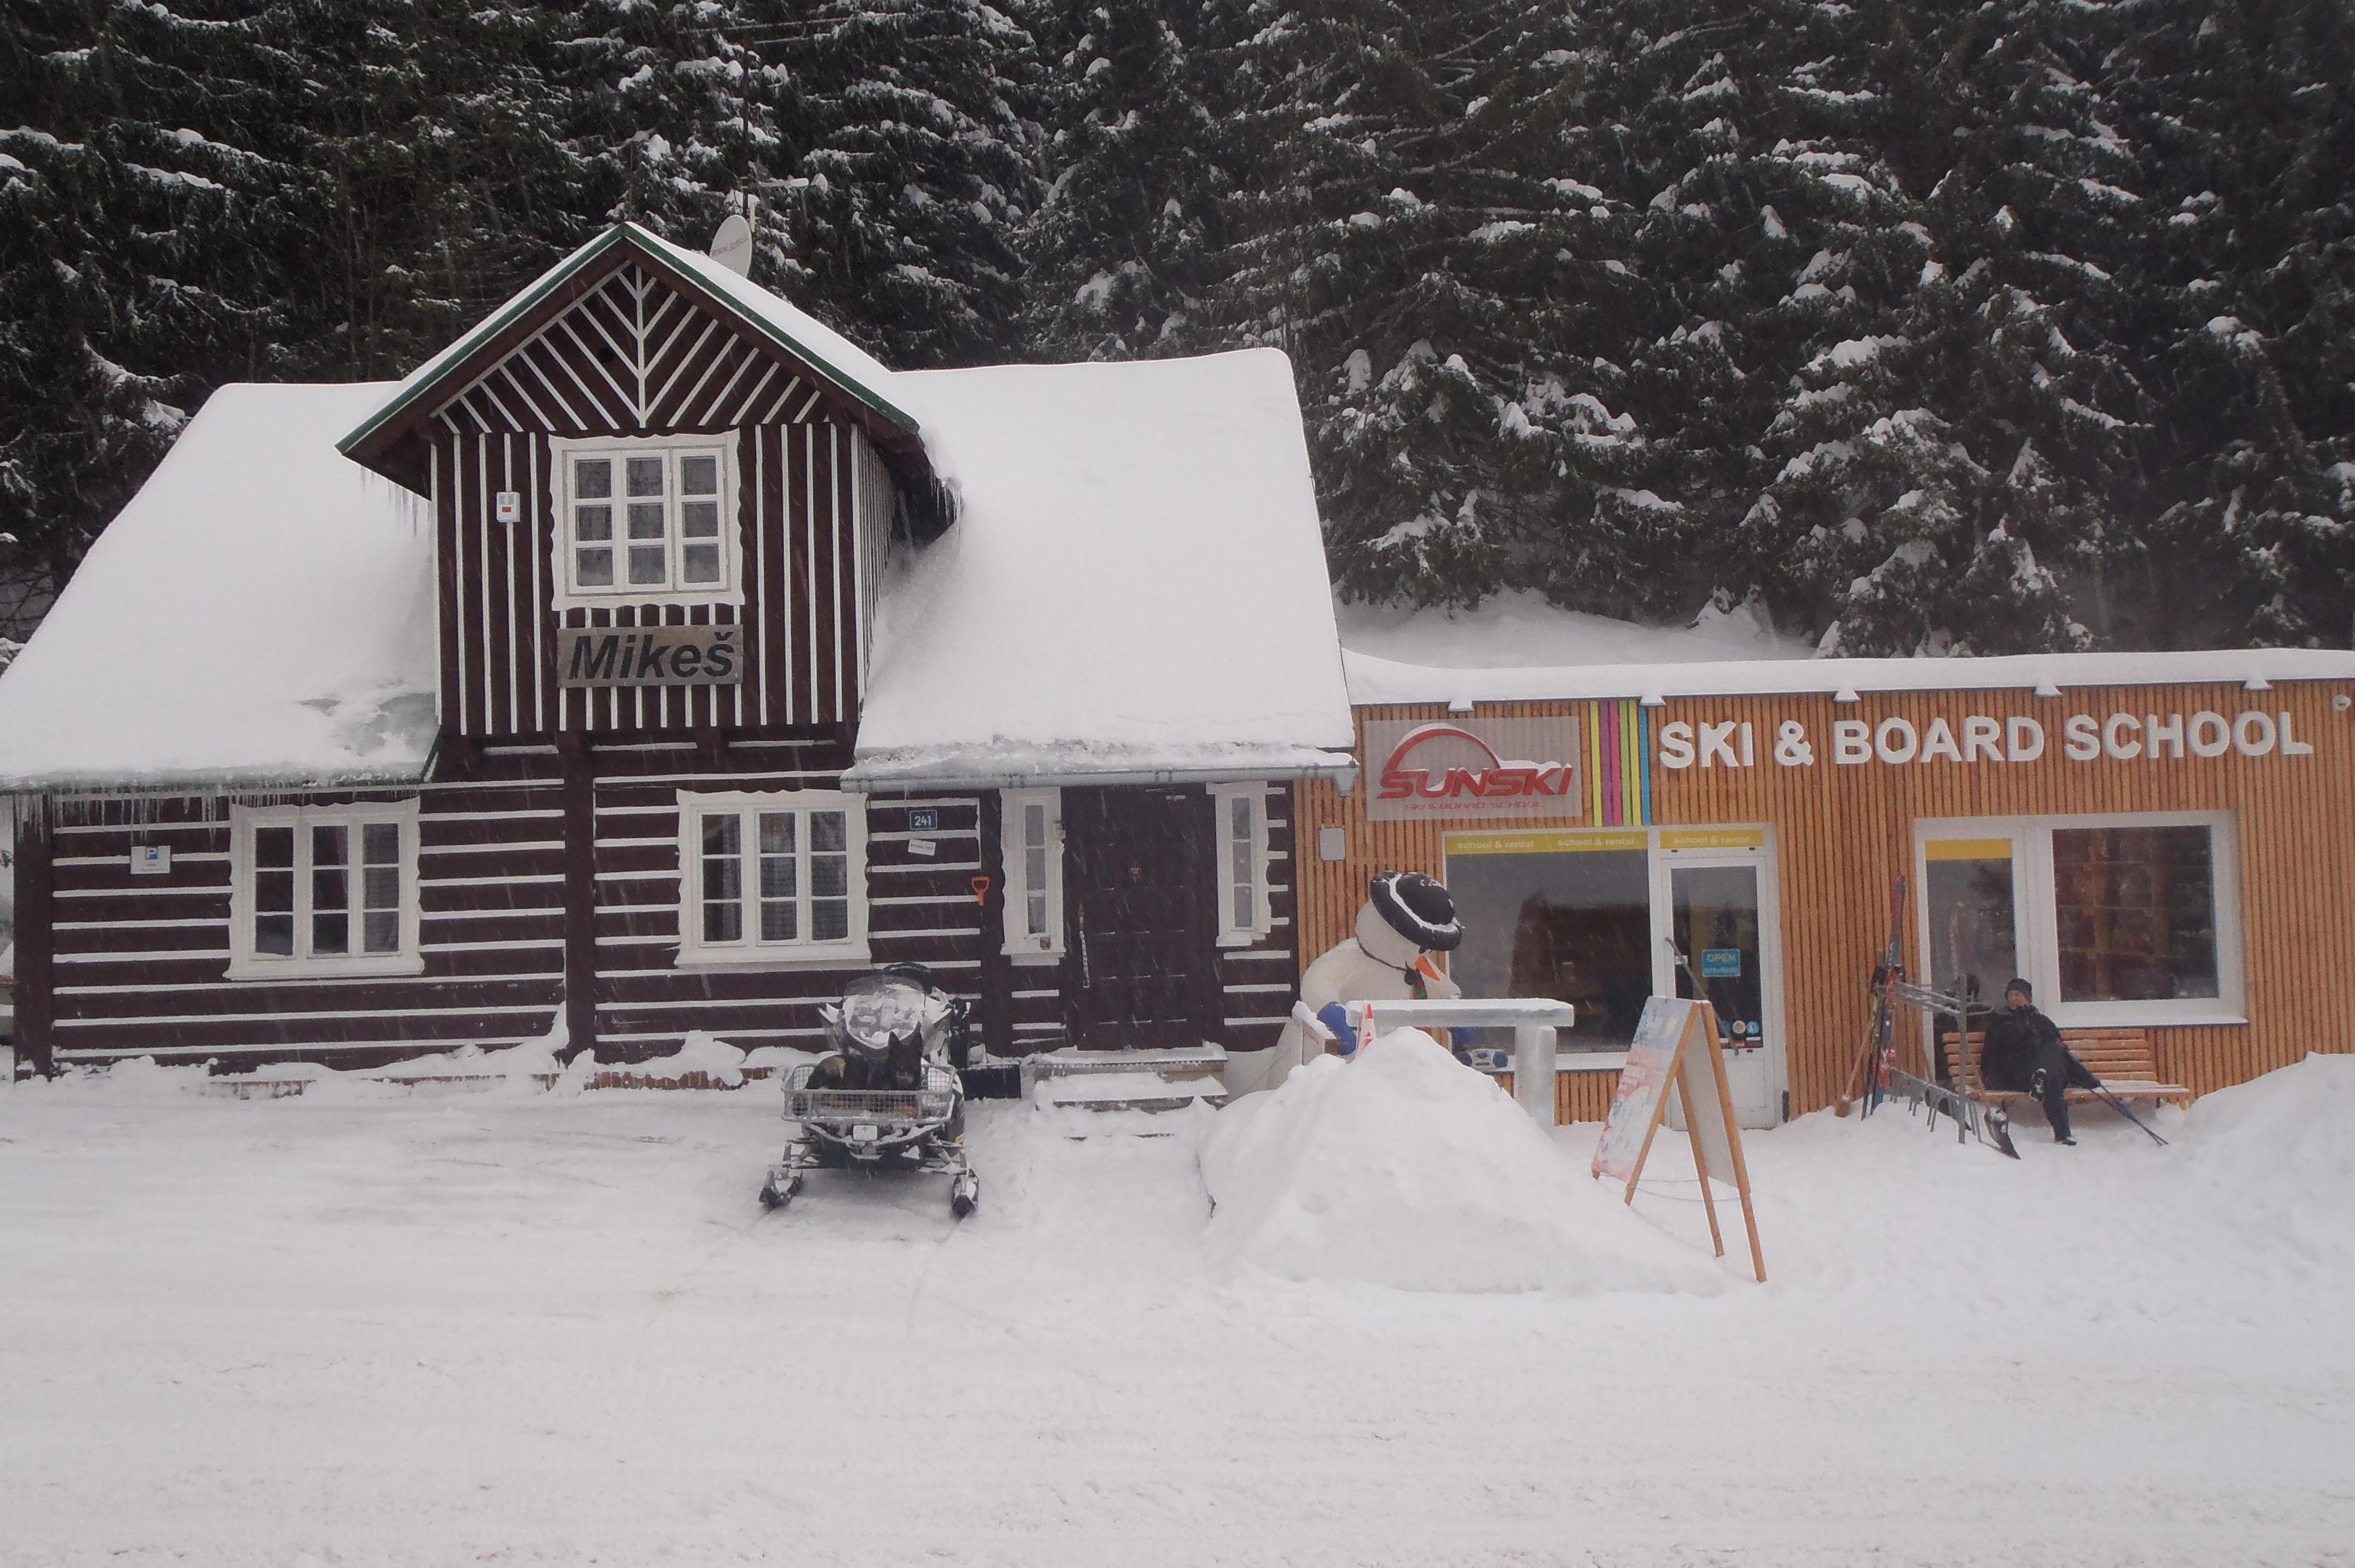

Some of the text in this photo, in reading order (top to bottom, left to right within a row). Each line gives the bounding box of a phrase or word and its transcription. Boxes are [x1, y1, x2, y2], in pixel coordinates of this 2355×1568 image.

[569, 632, 734, 679] Mikeš
[1659, 711, 2313, 768] SKI & BOARD SCHOOL
[1377, 767, 1574, 799] SUNSKI
[914, 815, 932, 827] 241
[1505, 840, 1534, 848] rental
[1558, 837, 1635, 847] school & rental
[1674, 835, 1750, 844] school & rental
[147, 848, 157, 859] P
[1707, 953, 1735, 963] OPEN
